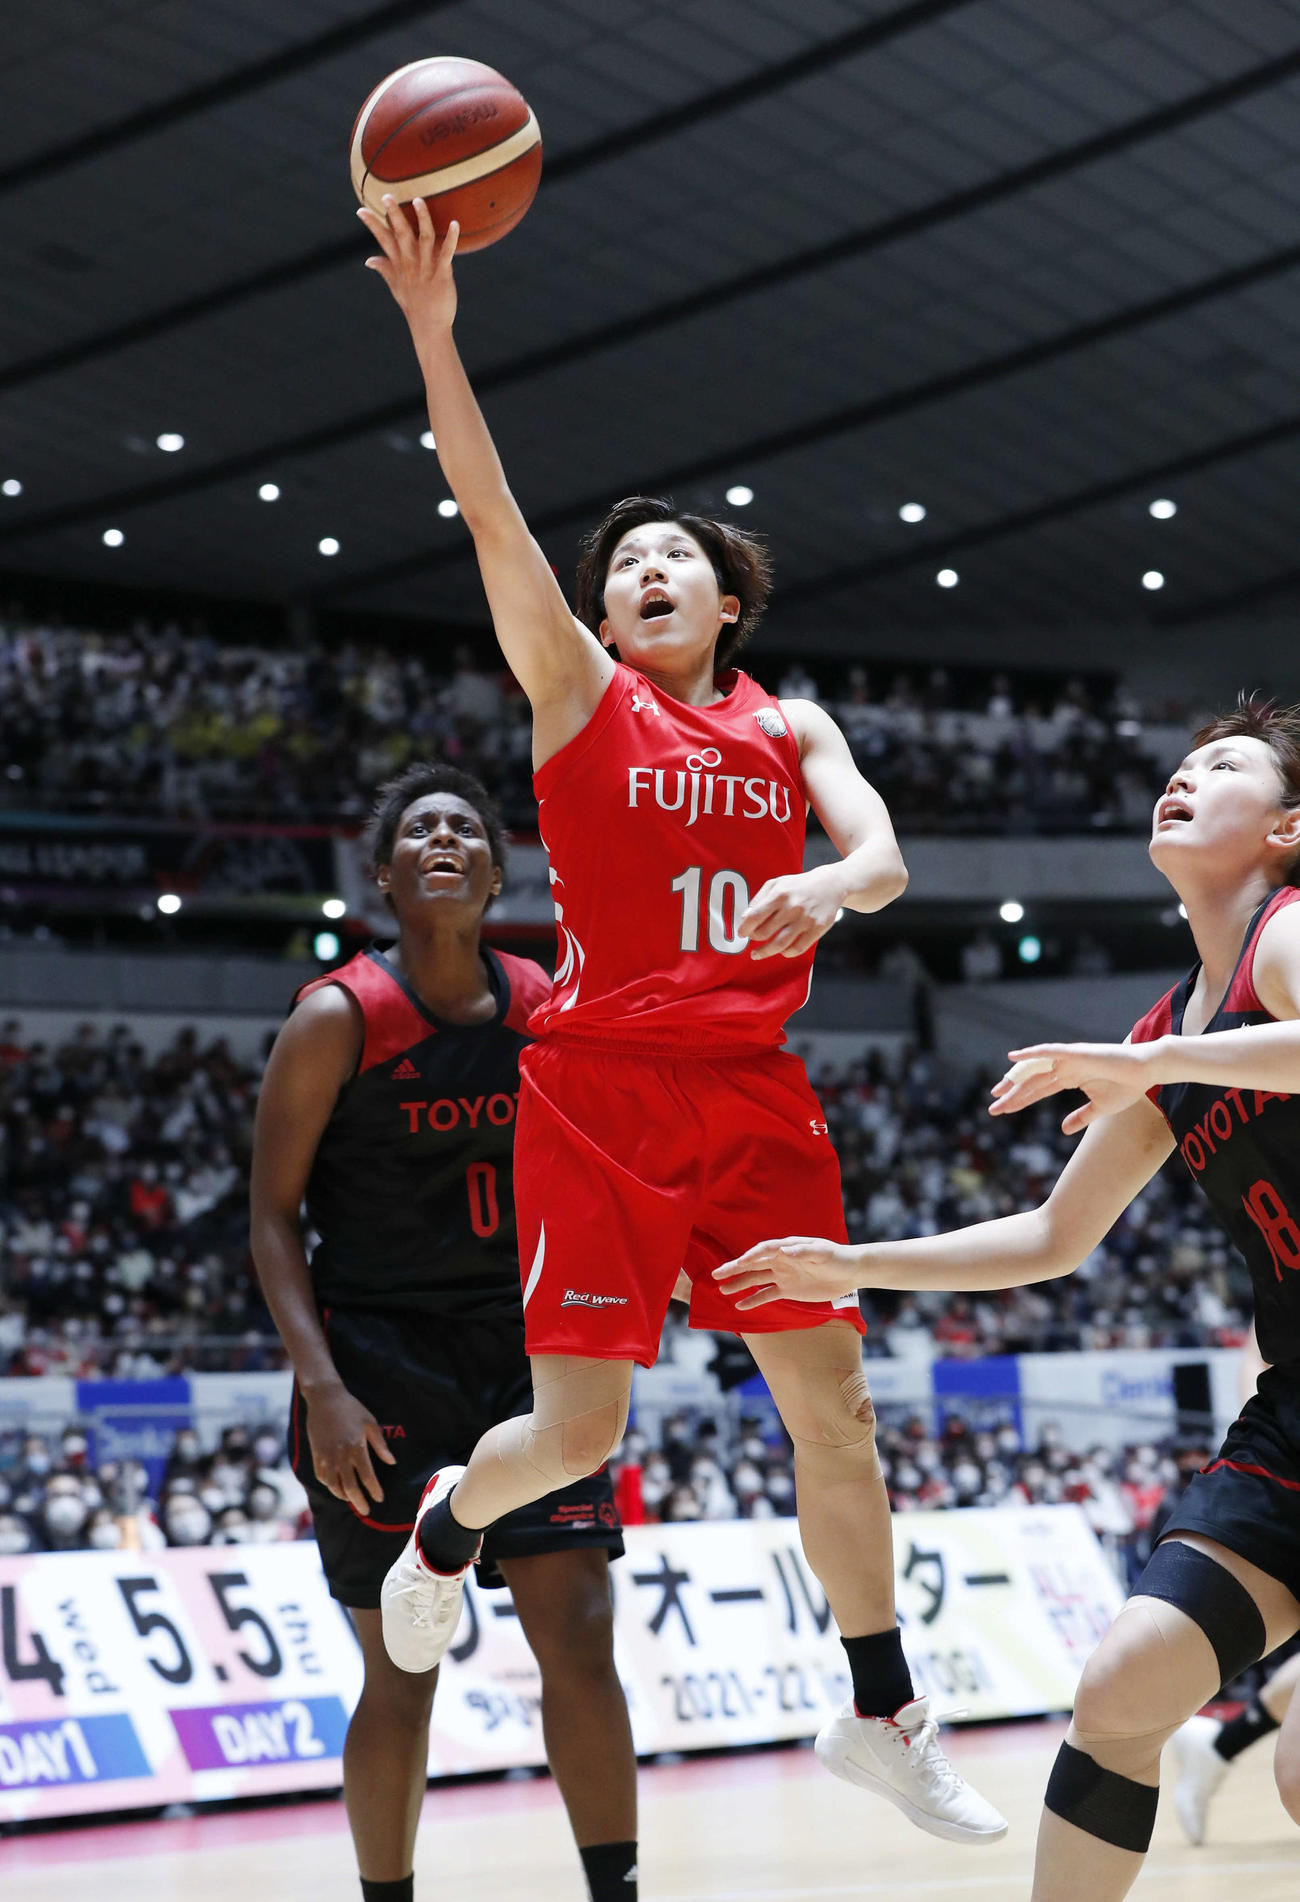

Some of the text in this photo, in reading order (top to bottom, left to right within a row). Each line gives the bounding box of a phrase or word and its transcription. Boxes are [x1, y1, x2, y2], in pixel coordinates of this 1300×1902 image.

[627, 766, 791, 827] FUJITSU
[671, 866, 750, 954] 10
[399, 1093, 519, 1133] TOYO
[466, 1162, 499, 1237] 0
[563, 1289, 628, 1305] Red Wave
[116, 1572, 283, 1684] 5.5
[211, 1702, 325, 1764] DAY2
